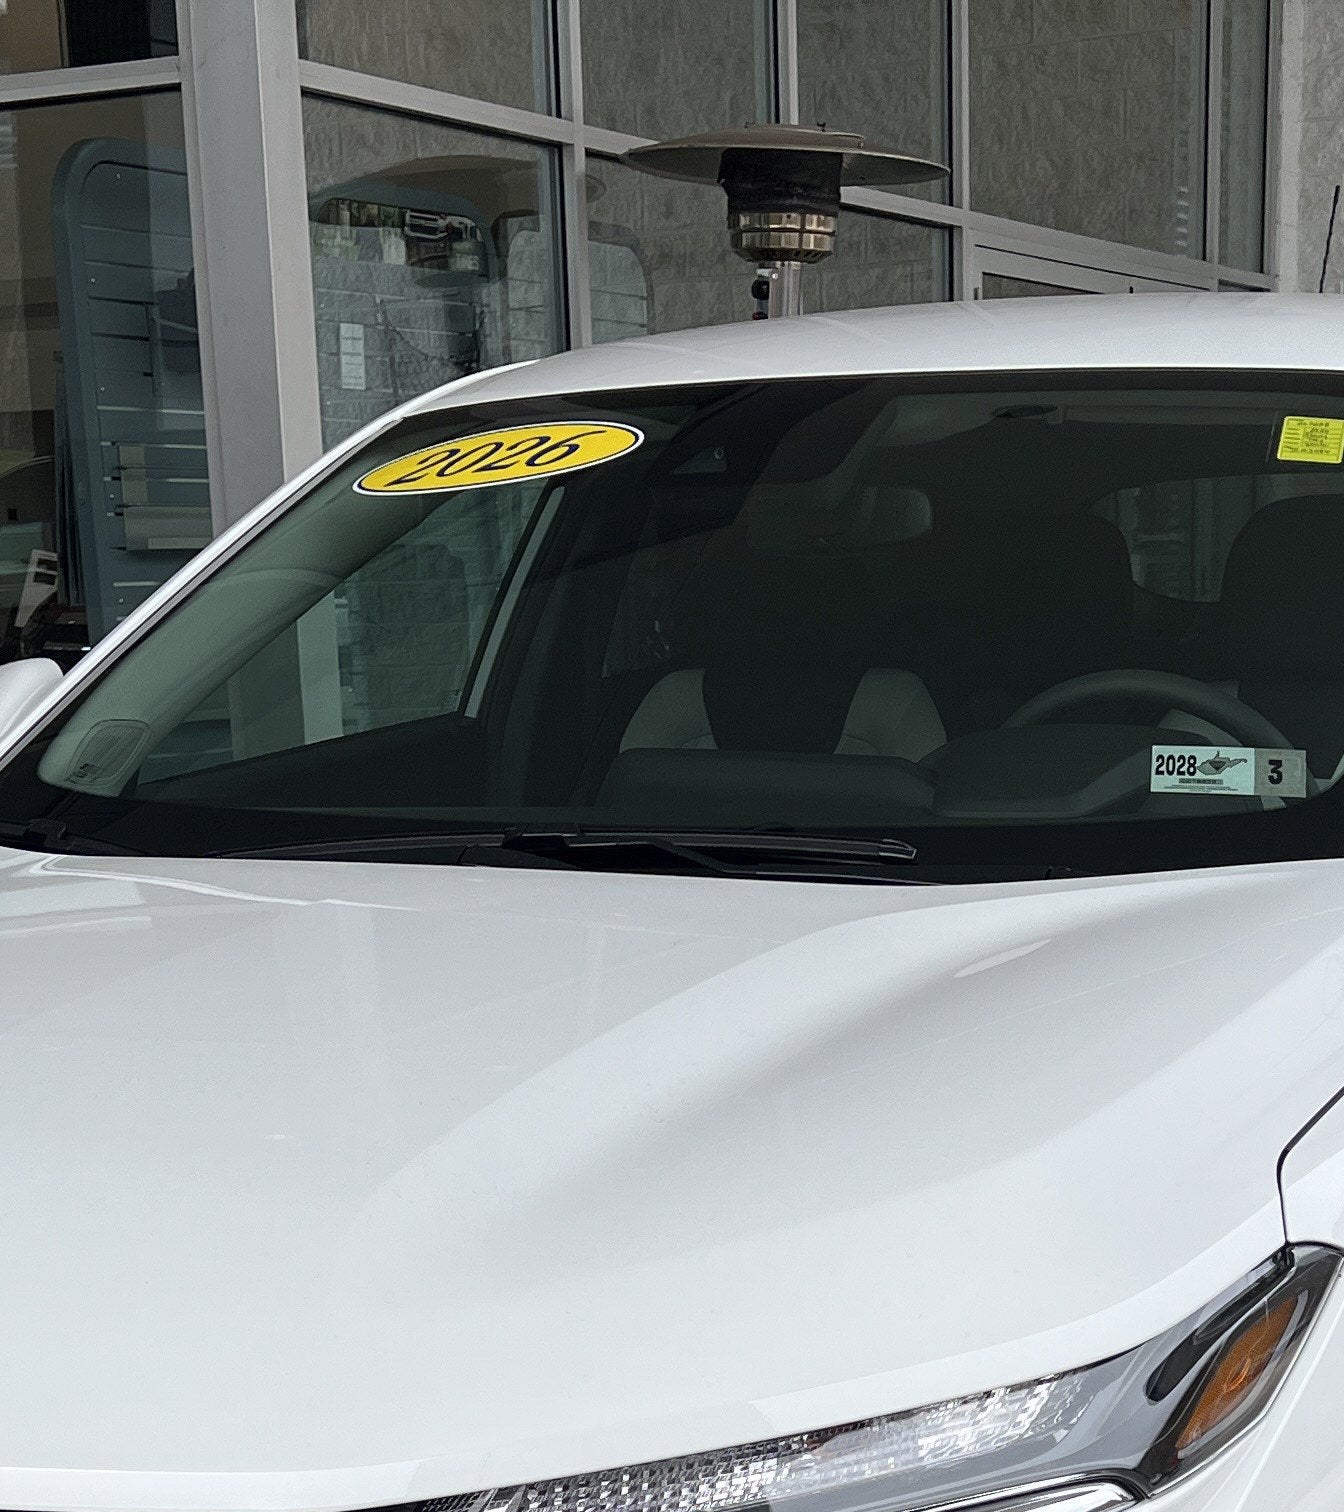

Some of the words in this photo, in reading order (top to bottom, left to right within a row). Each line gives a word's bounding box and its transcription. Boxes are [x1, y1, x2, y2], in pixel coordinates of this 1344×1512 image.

[383, 430, 607, 487] 2026
[1155, 754, 1197, 777] 2028
[1267, 759, 1284, 785] 3
